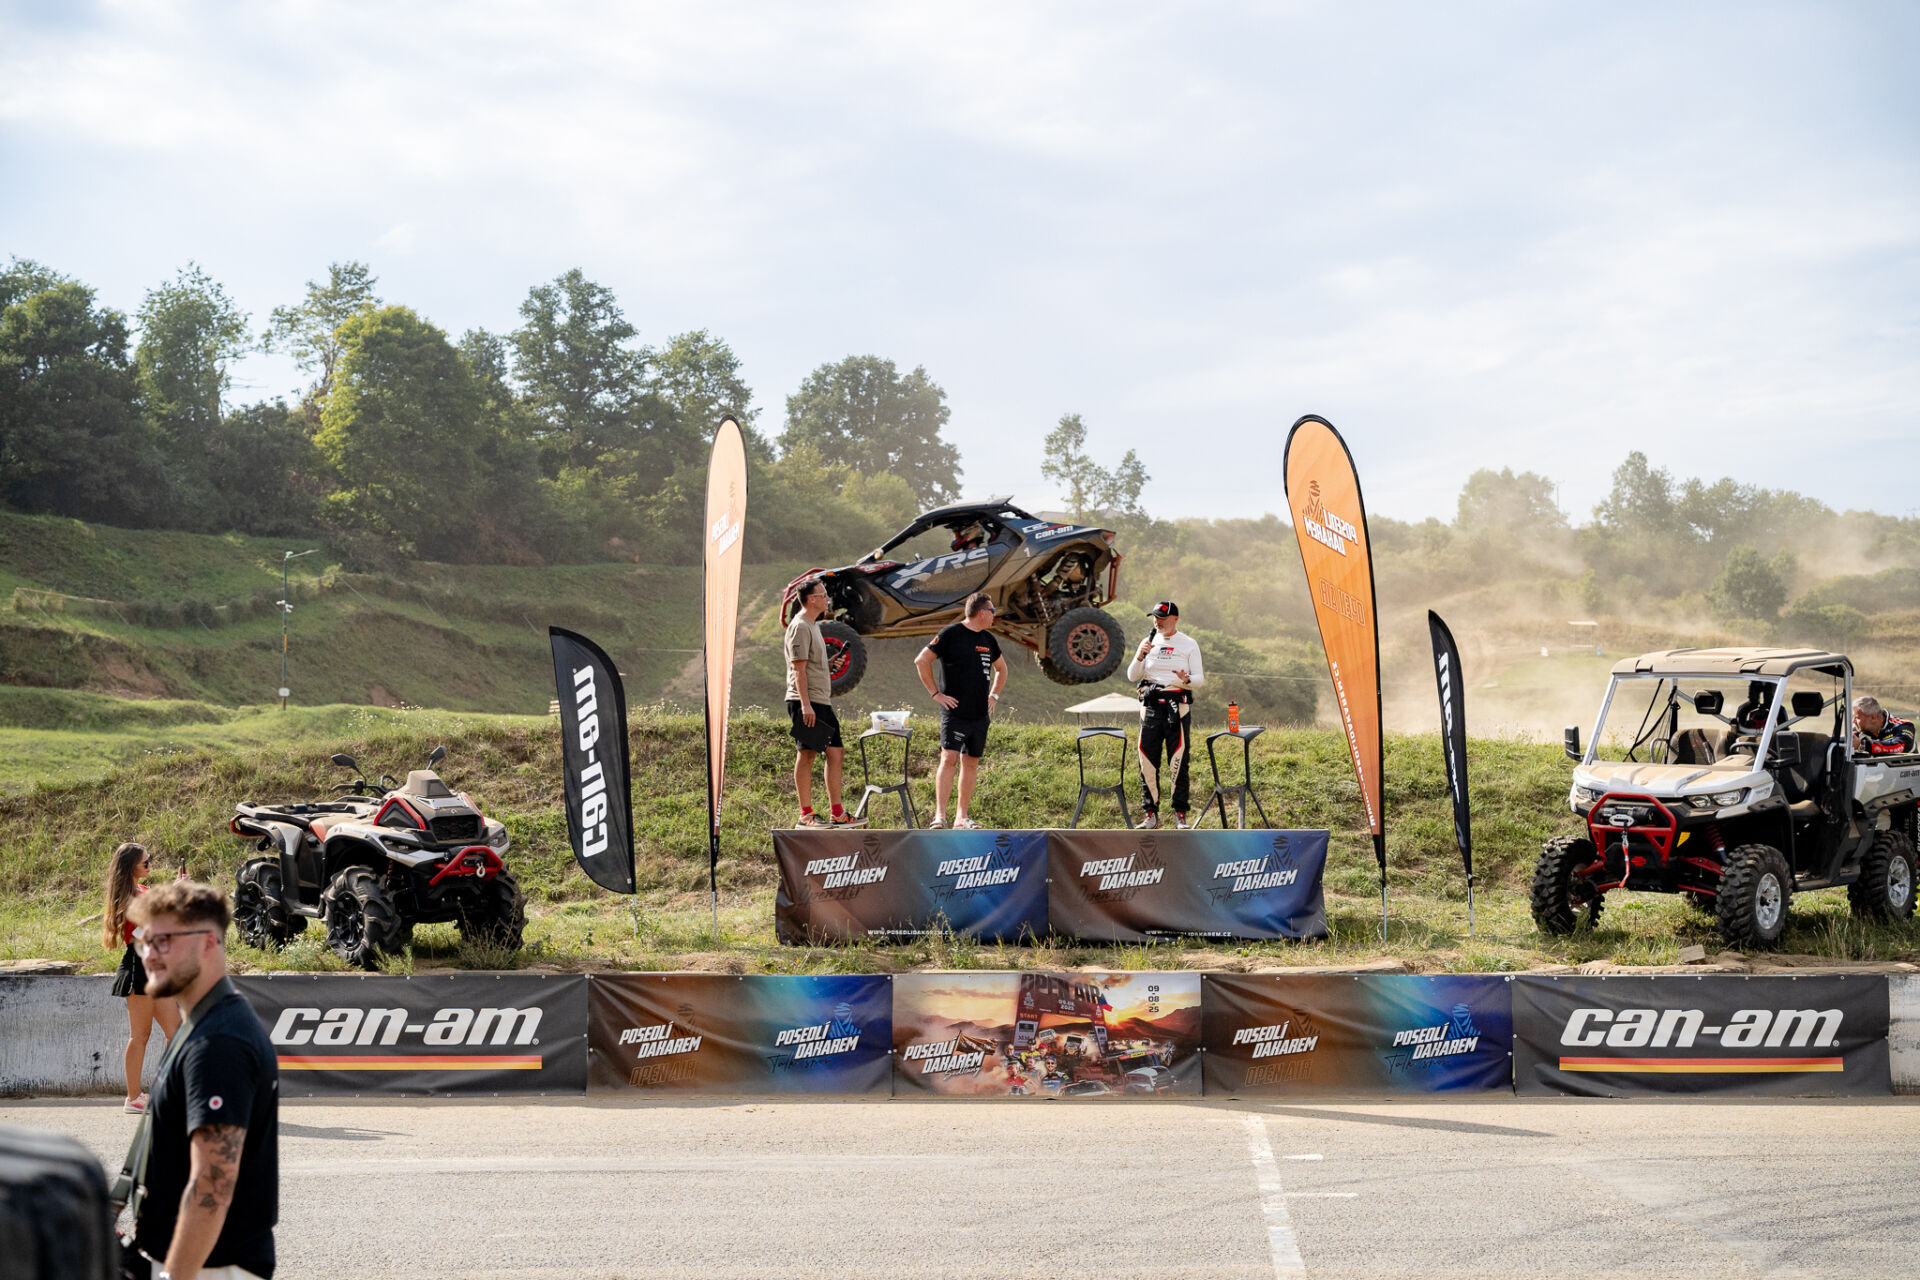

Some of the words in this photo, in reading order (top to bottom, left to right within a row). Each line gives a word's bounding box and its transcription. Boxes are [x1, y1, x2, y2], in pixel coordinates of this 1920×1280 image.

[804, 851, 860, 877] POSEDLÍ
[936, 851, 993, 877] POSEDLÍ
[1080, 853, 1136, 878] POSEDLÍ
[1213, 854, 1270, 879] POSEDLÍ
[823, 866, 888, 890] DAKAREM
[954, 866, 1021, 890] DAKAREM
[1098, 867, 1165, 891] DAKAREM
[1232, 869, 1298, 892] DAKAREM
[270, 1007, 543, 1045] can-am
[619, 1020, 675, 1046] POSEDLÍ
[775, 1021, 831, 1047] POSEDLÍ
[1232, 1020, 1289, 1045] POSEDLÍ
[1392, 1022, 1450, 1047] POSEDLÍ
[1560, 1008, 1844, 1047] can-am
[637, 1036, 703, 1059] DAKAREM
[794, 1035, 860, 1060] DAKAREM
[903, 1037, 957, 1061] POSEDLÍ
[1252, 1036, 1318, 1059] DAKAREM
[1412, 1036, 1479, 1060] DAKAREM
[629, 1063, 669, 1087] OPEN
[921, 1051, 985, 1075] DAKAREM
[1245, 1063, 1285, 1087] OPEN
